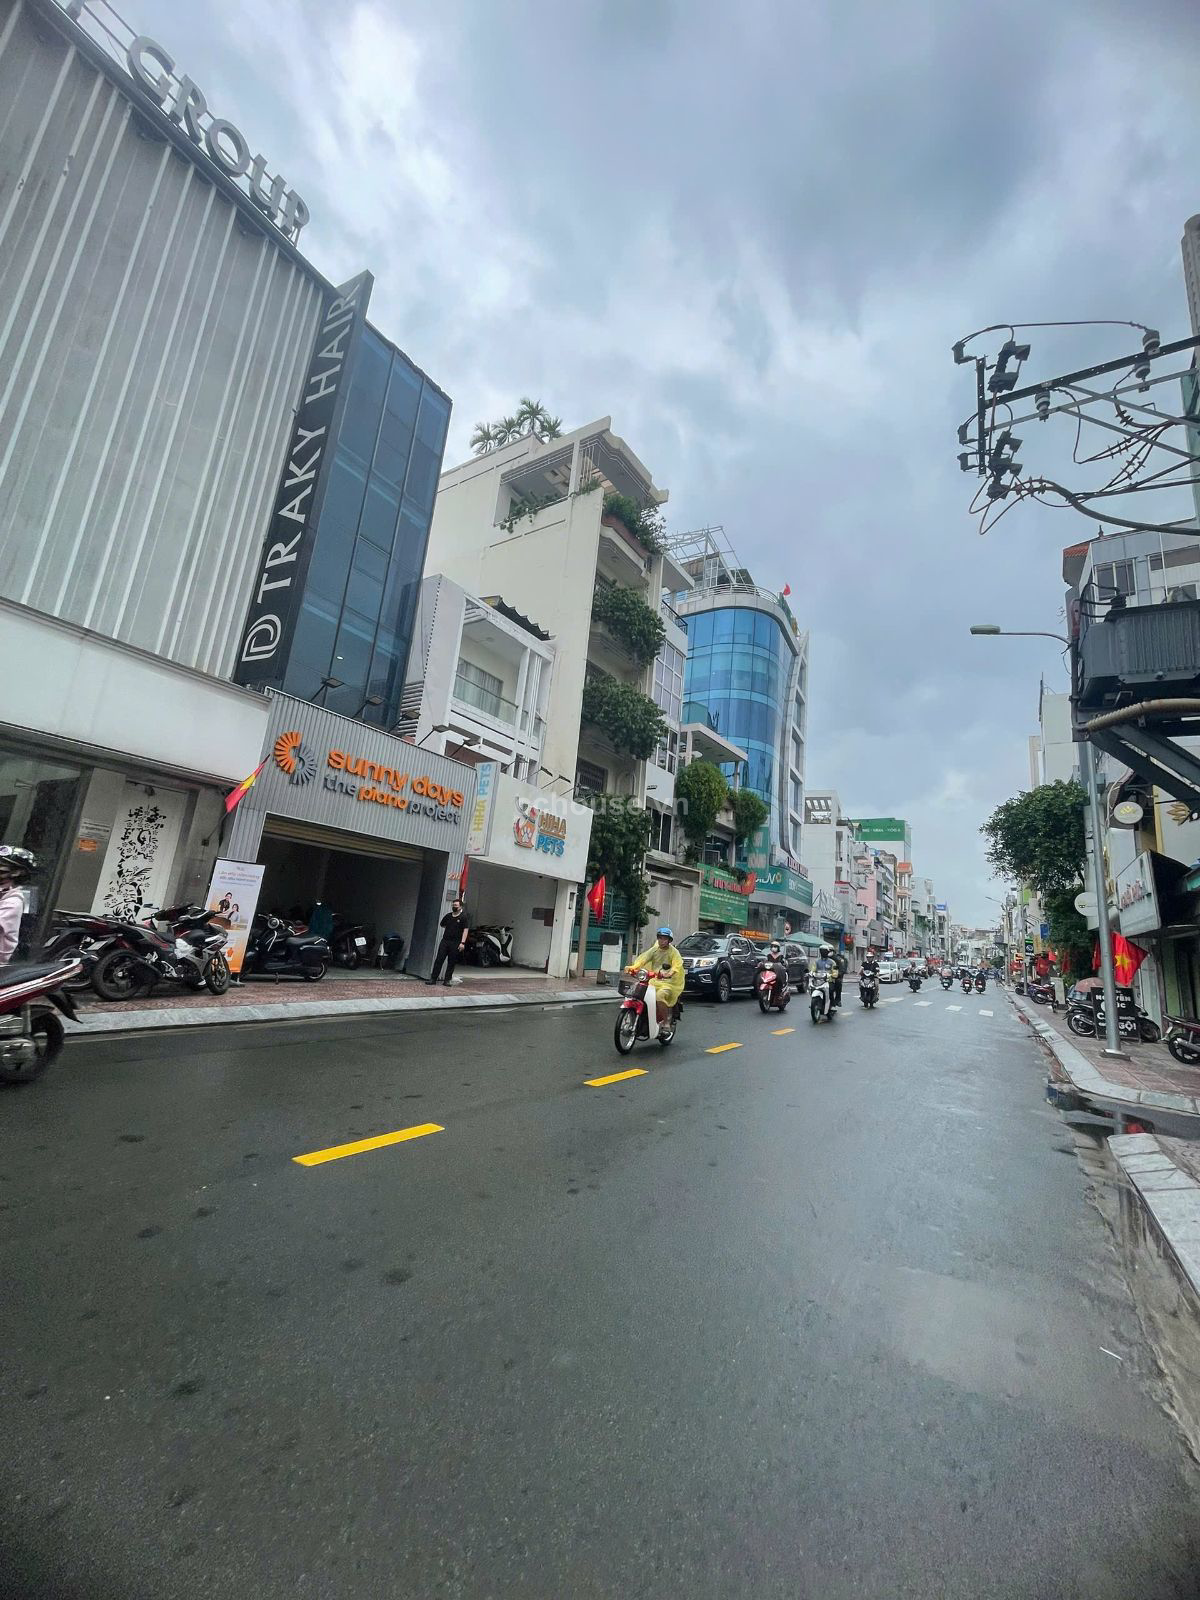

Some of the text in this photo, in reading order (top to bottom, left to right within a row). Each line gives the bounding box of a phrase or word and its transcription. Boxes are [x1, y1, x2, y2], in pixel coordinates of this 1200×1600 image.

[127, 35, 310, 237] GROUP
[257, 283, 361, 603] TRAKY HAIR
[324, 774, 461, 825] the piano project
[327, 748, 465, 807] sunny days
[478, 763, 492, 796] PETS
[535, 834, 565, 857] PETS
